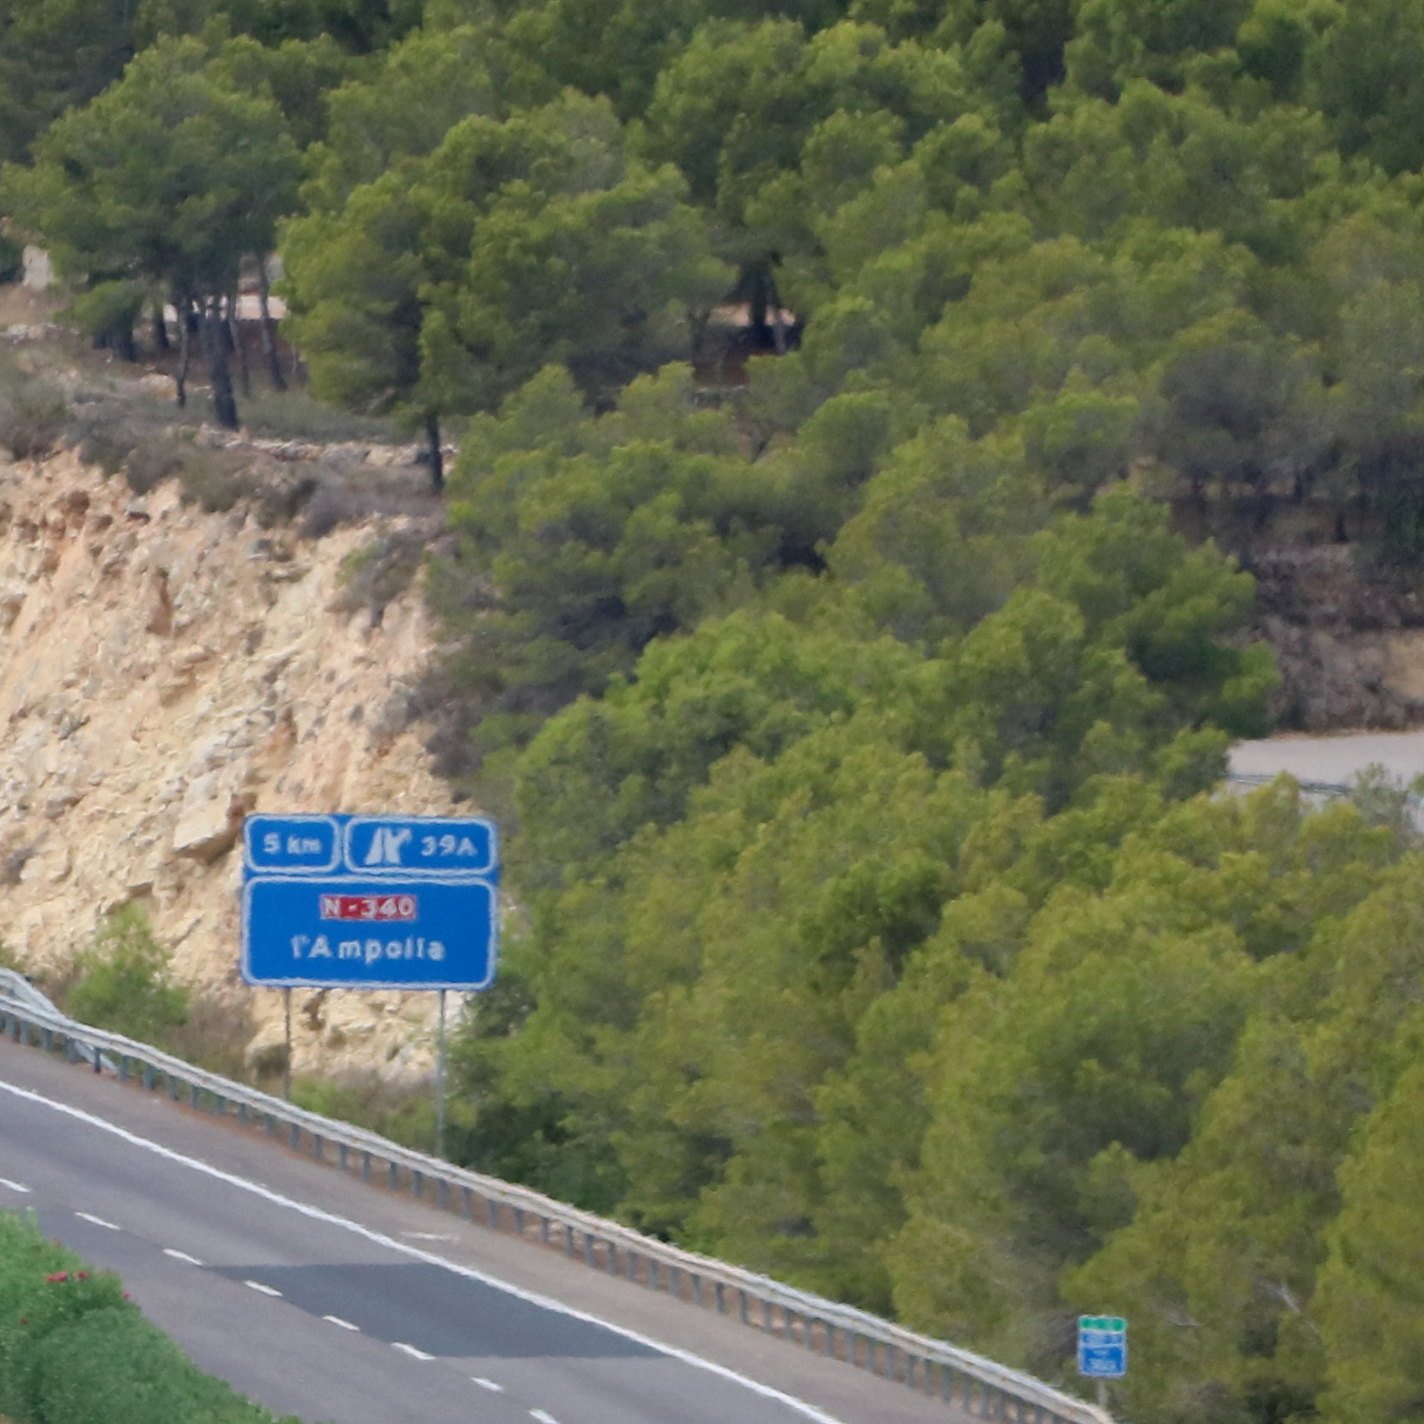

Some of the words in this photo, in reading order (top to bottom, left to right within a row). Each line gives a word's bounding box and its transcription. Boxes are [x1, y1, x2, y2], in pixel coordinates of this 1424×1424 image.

[287, 833, 323, 855] km
[419, 834, 479, 857] 39A
[322, 897, 415, 918] N-340
